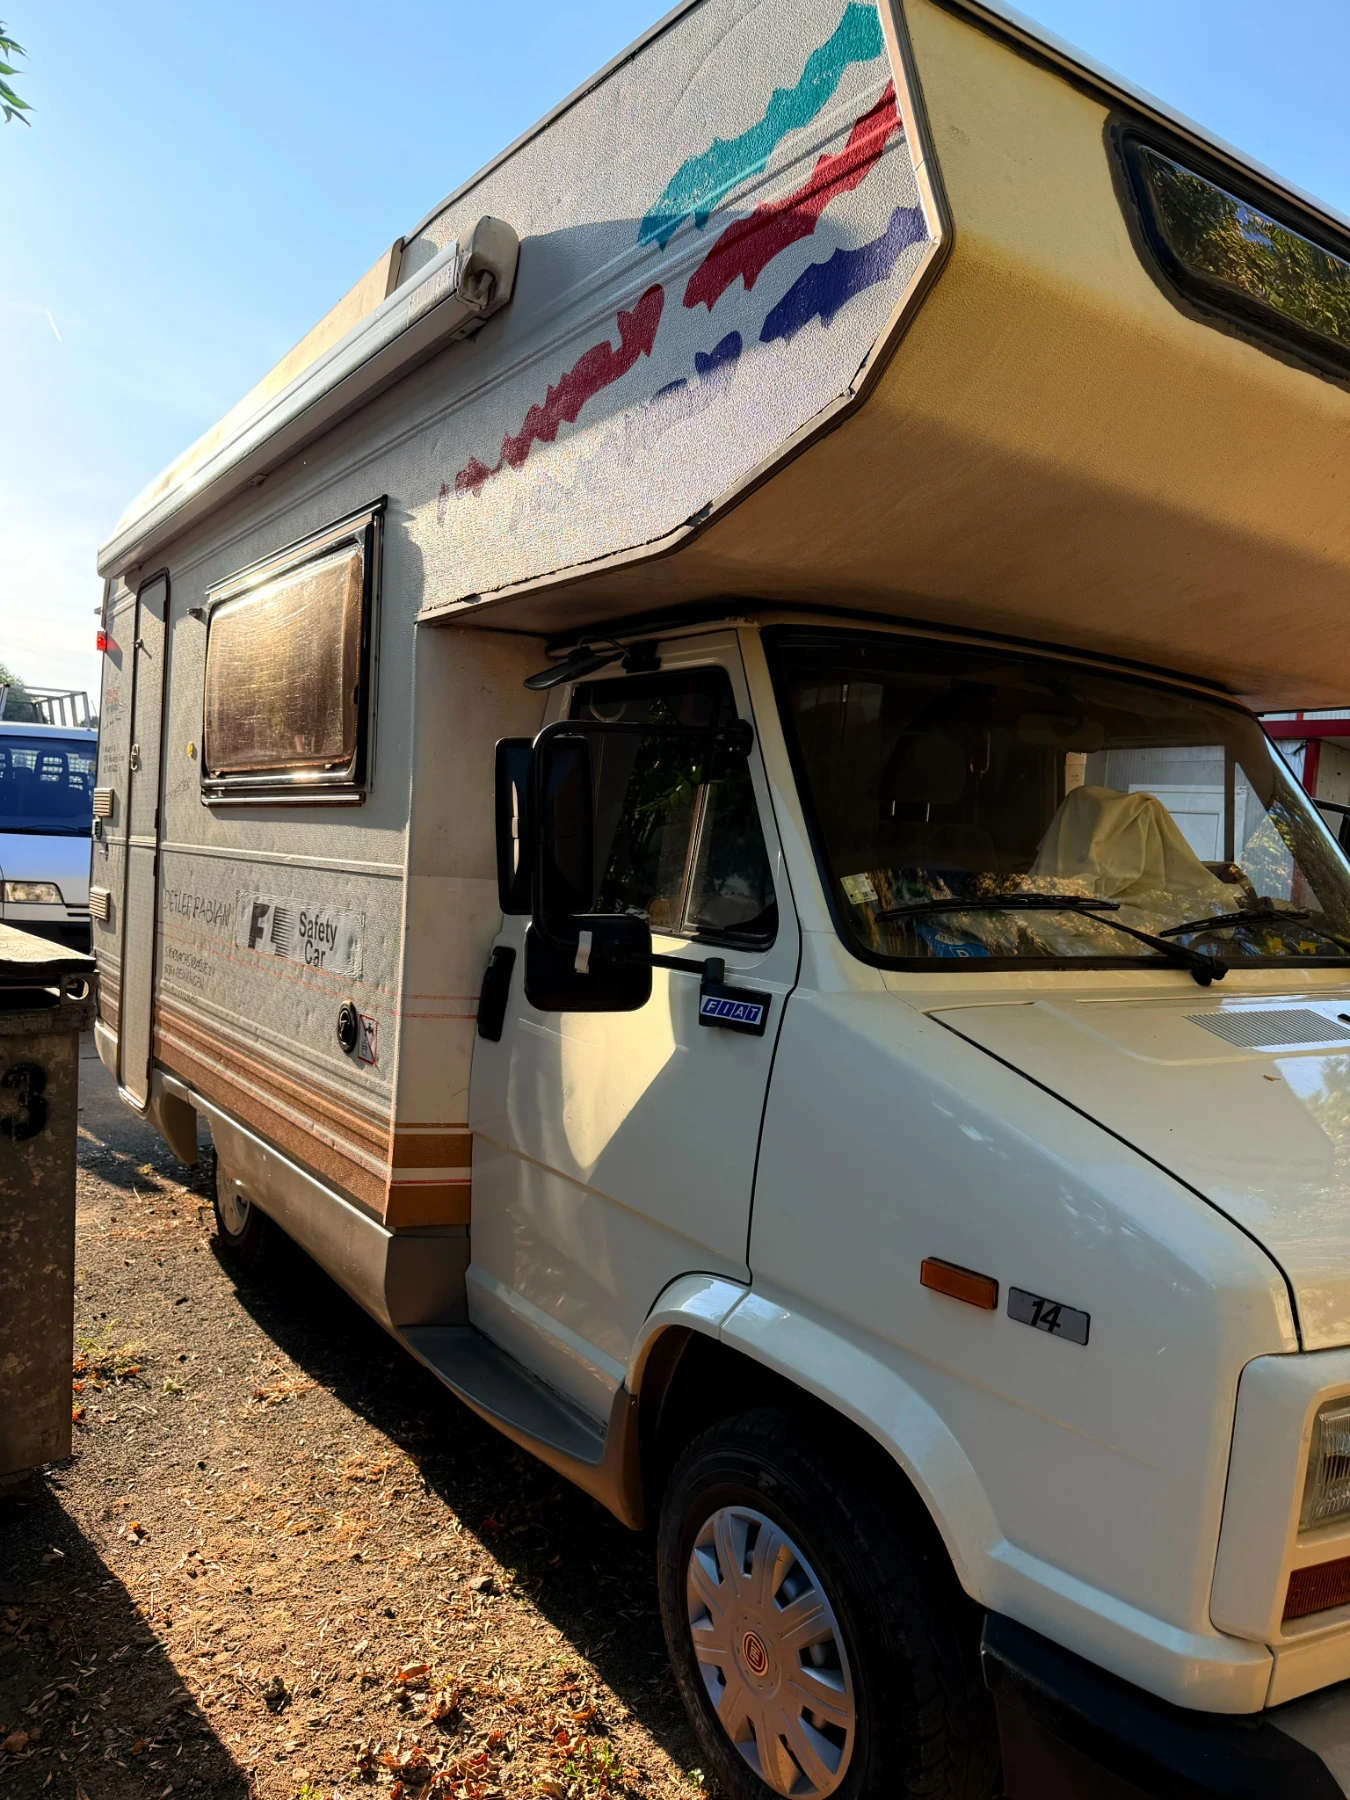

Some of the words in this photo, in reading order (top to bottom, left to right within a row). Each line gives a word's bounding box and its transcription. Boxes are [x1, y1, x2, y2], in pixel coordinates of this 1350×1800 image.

[299, 911, 338, 951] Safety
[304, 939, 326, 968] Car
[706, 1001, 759, 1019] FIAT
[1030, 1299, 1062, 1334] 14
